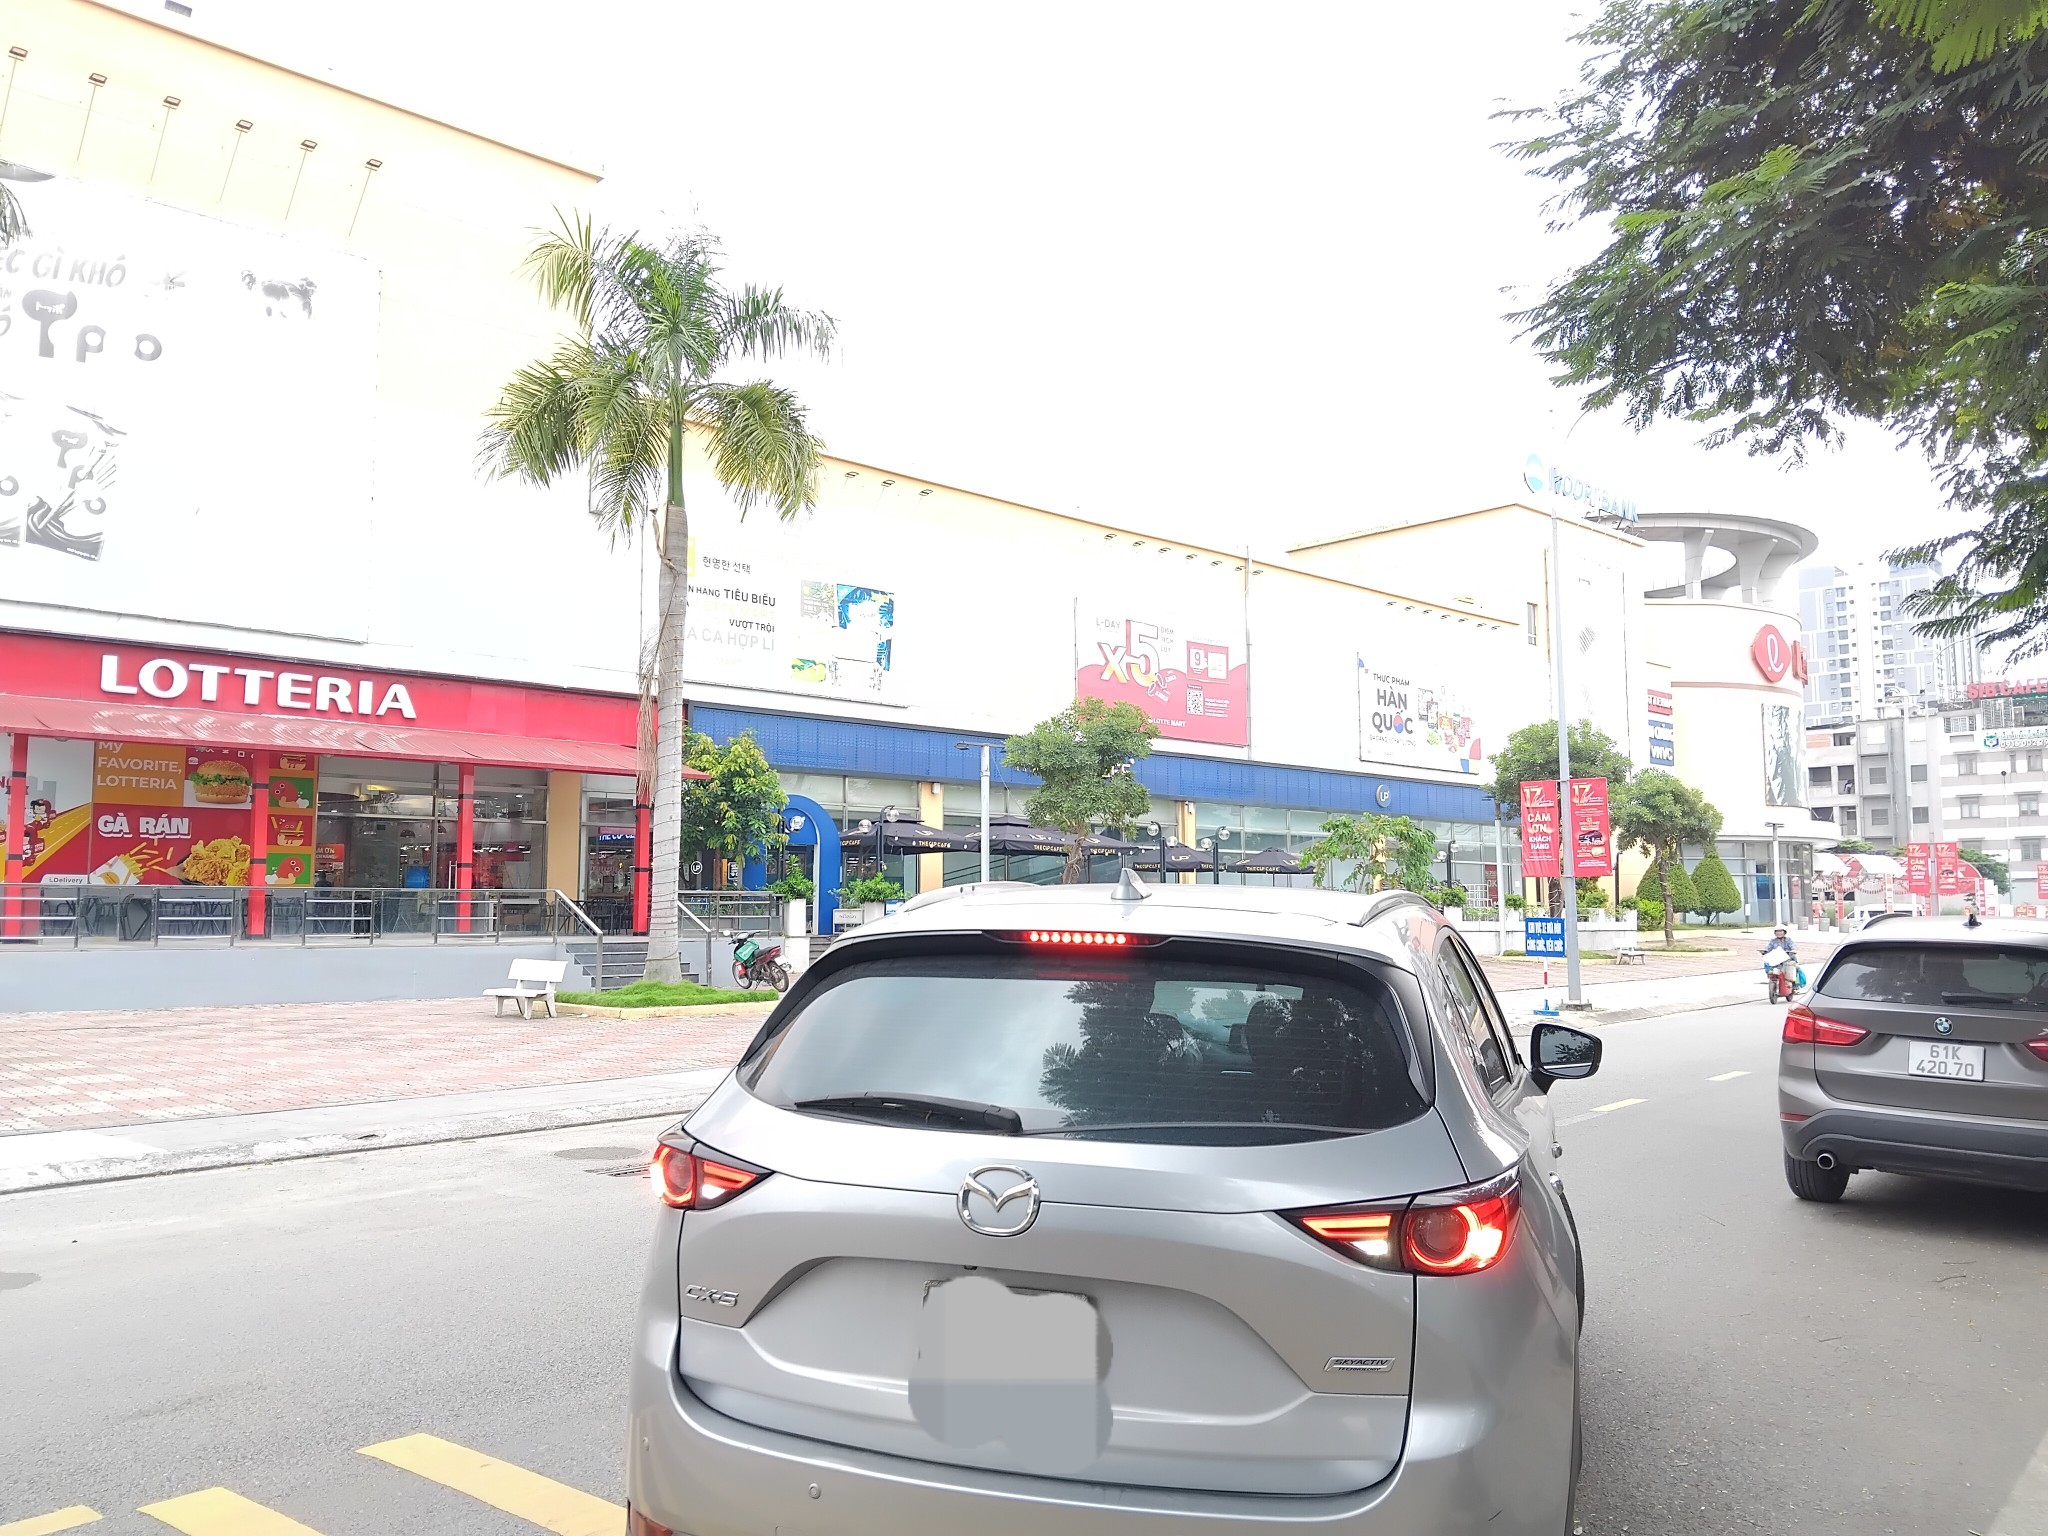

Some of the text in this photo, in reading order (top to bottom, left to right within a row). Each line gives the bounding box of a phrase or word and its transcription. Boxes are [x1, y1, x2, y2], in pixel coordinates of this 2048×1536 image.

[31, 246, 65, 279] GÌ
[68, 254, 126, 288] KHÓ
[702, 556, 751, 574] 현명한 선택
[724, 588, 748, 602] TIÊU
[729, 618, 775, 634] VƯỢT TRỘI
[727, 631, 759, 650] HỢP
[99, 654, 417, 720] LOTTERIA
[1377, 685, 1408, 711] HÀN
[1372, 709, 1414, 734] QUỐC
[99, 741, 123, 752] My
[97, 757, 182, 774] FAVORITE,
[97, 776, 177, 790] LOTTERIA
[97, 812, 192, 839] GÀ RÁN
[1527, 811, 1551, 823] CẢM
[1531, 823, 1547, 833] ƠN
[1930, 1044, 1961, 1060] 61K
[1916, 1059, 1974, 1078] 420.70
[685, 1284, 740, 1307] CX-5
